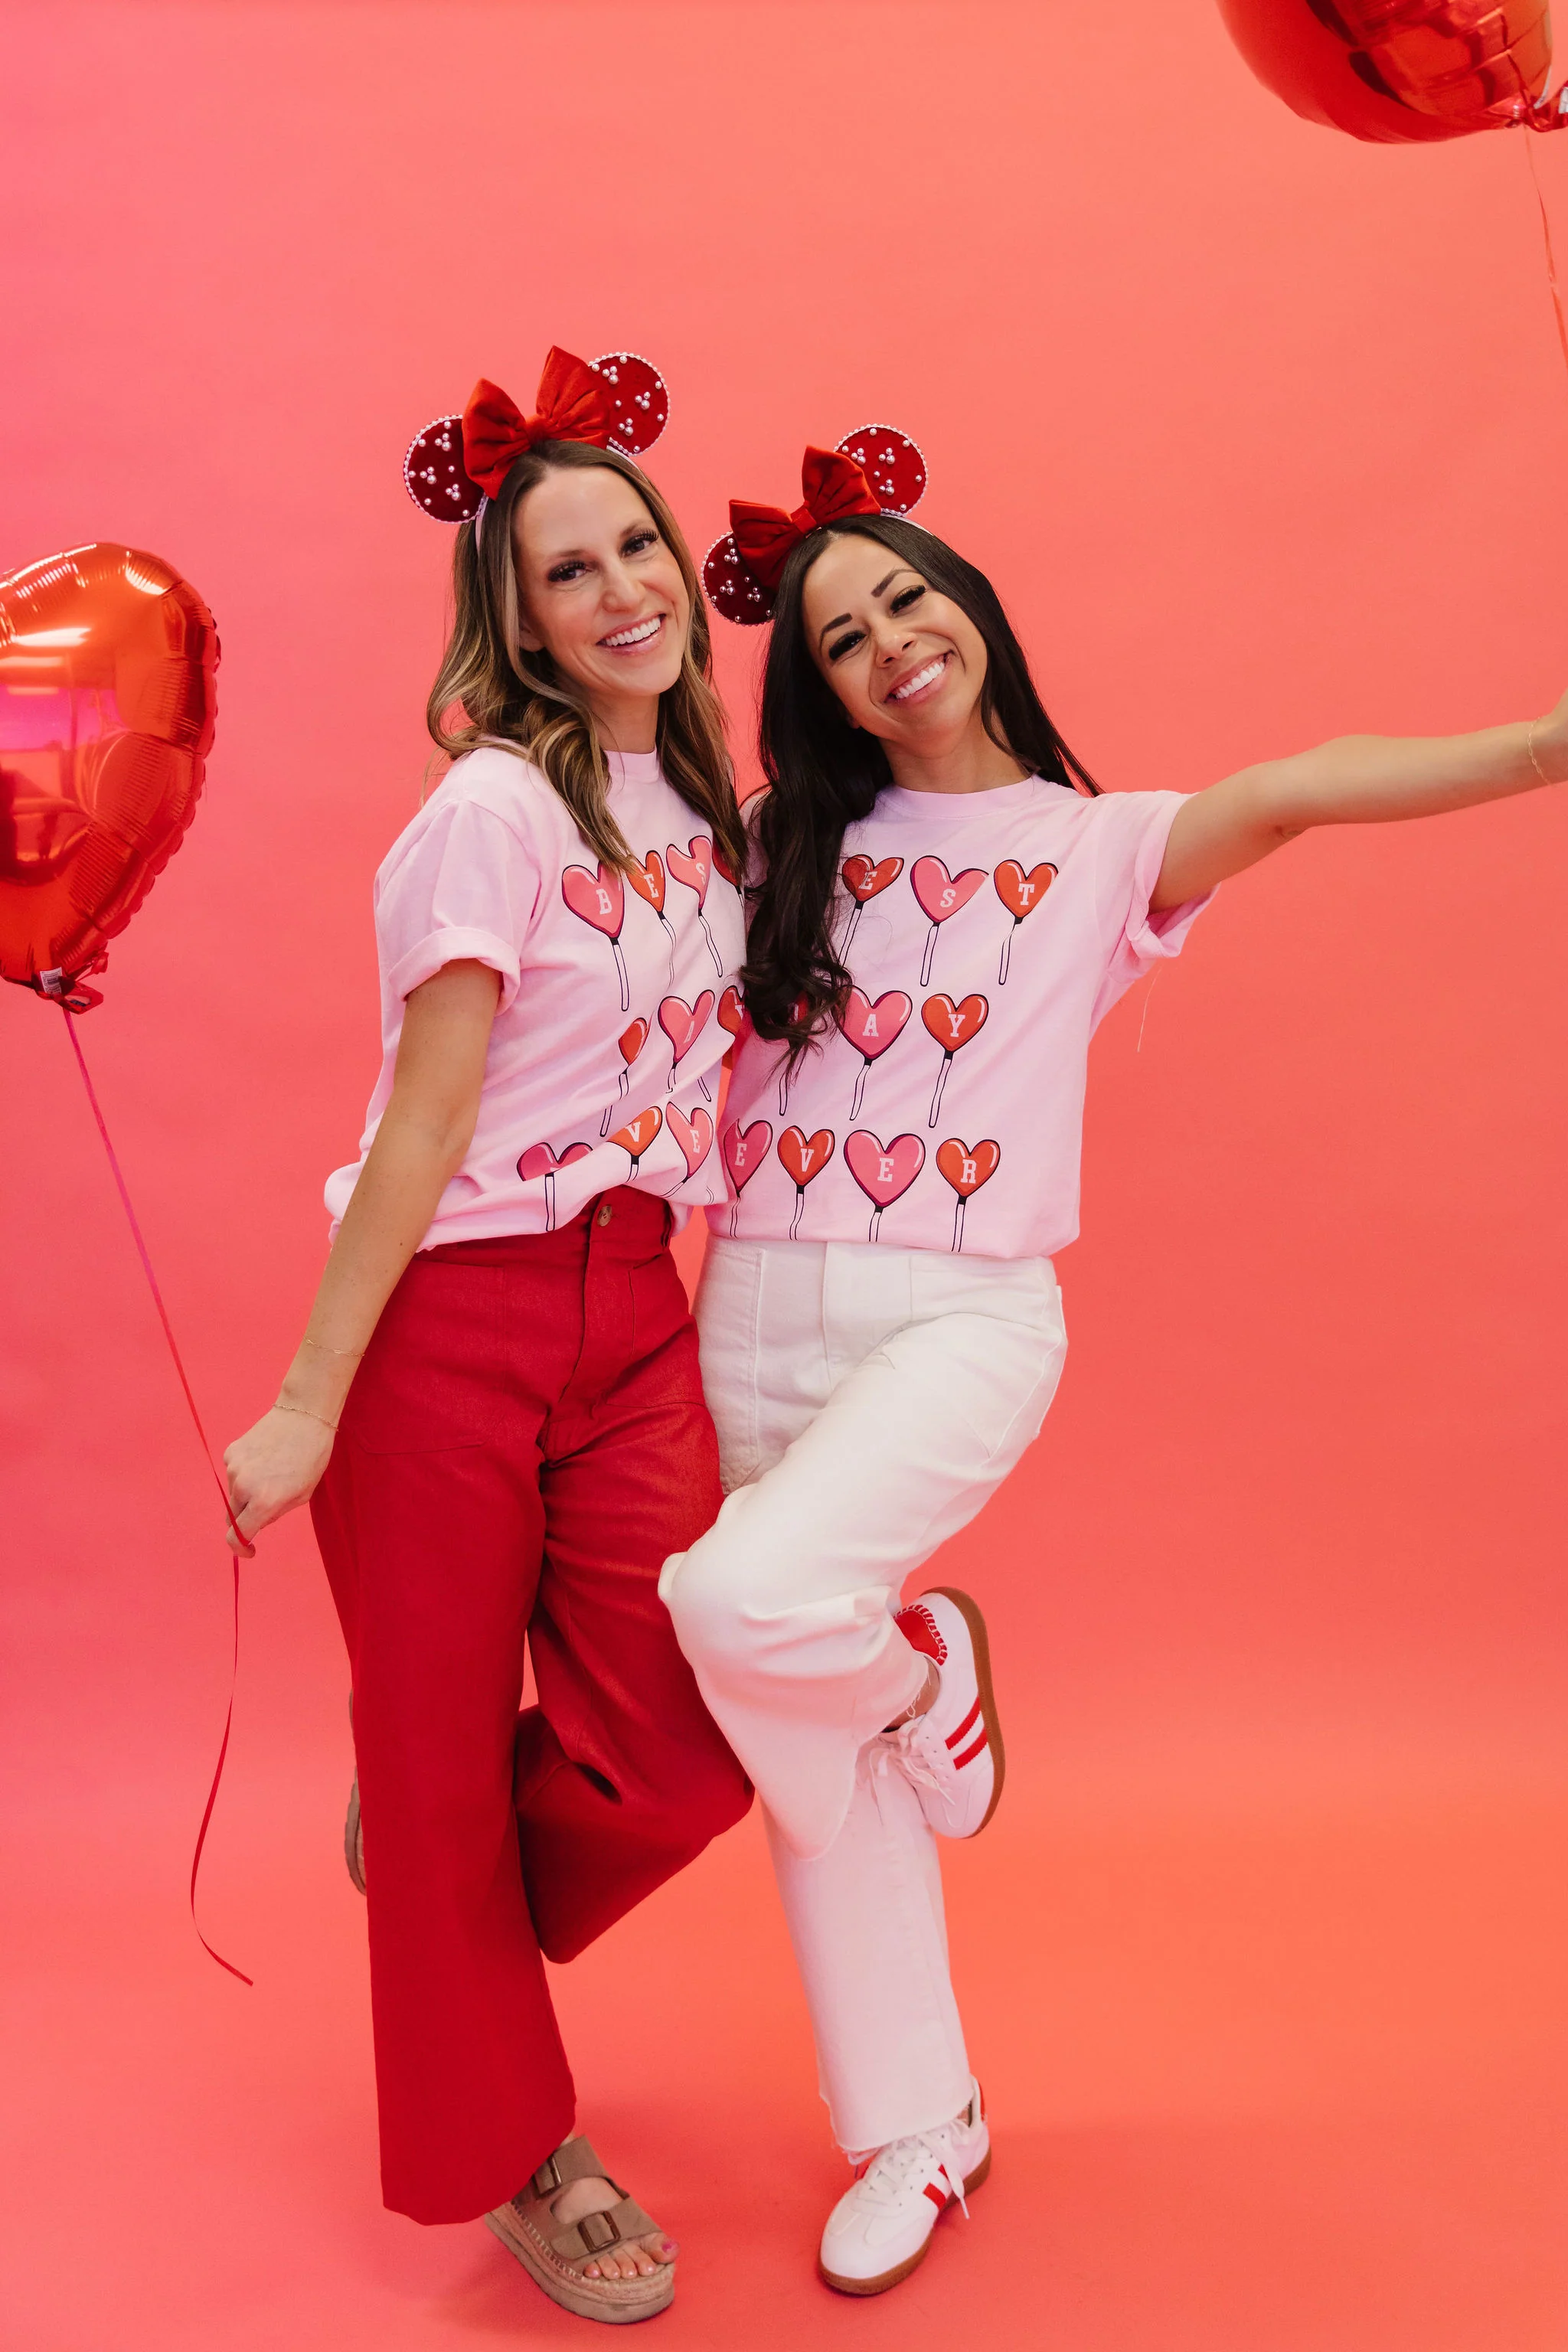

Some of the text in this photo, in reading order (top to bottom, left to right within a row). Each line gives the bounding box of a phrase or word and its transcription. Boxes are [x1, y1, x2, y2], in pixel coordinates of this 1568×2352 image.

[596, 862, 706, 914] BES
[861, 870, 1035, 908] EST
[735, 1142, 977, 1184] EVER
